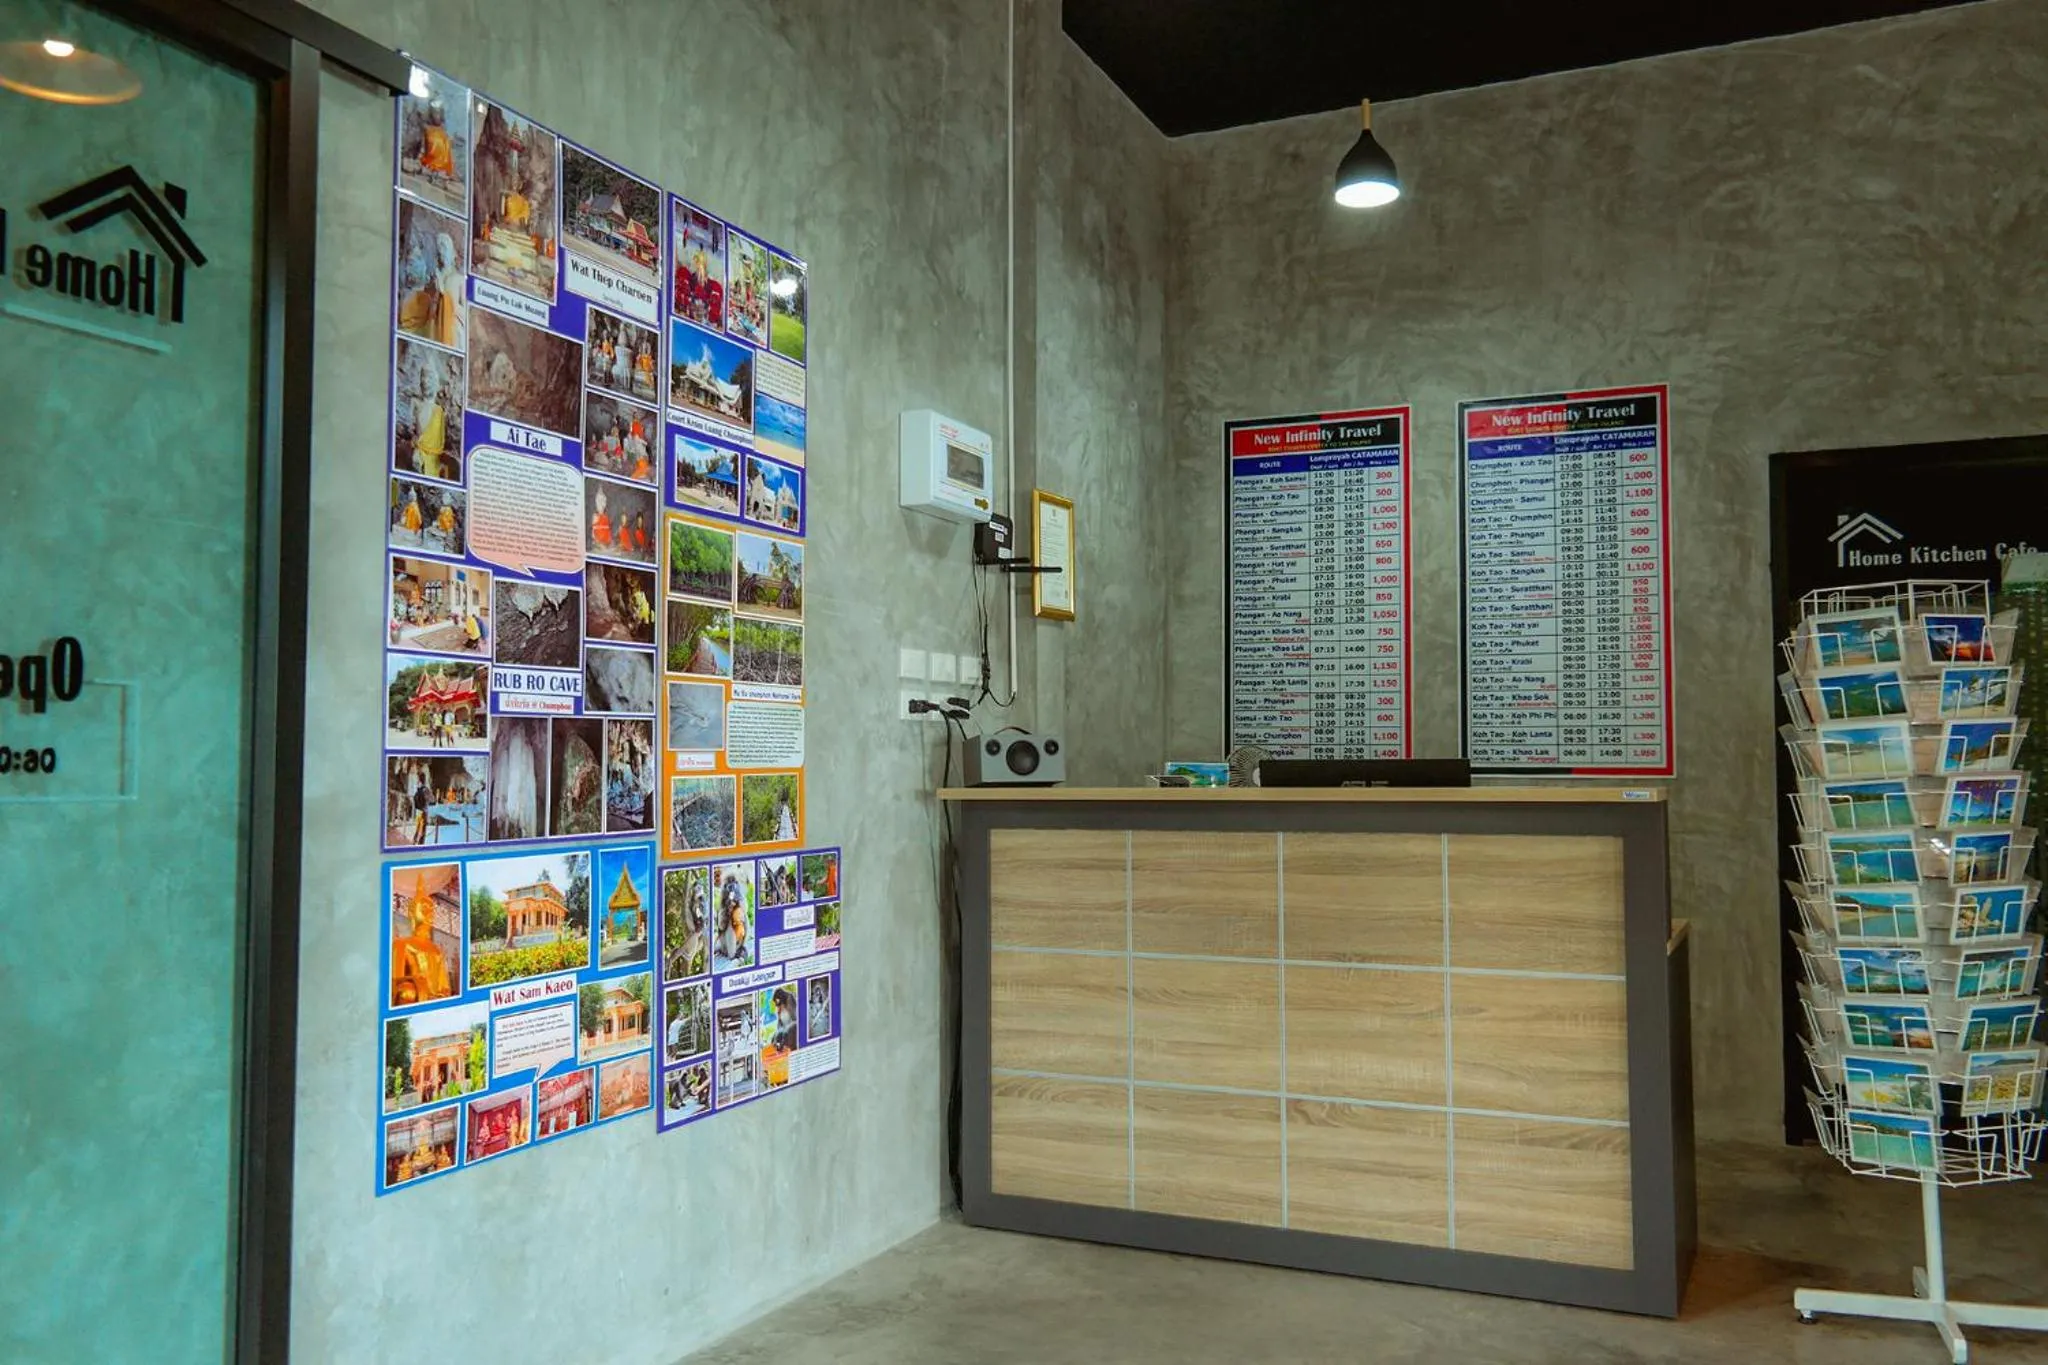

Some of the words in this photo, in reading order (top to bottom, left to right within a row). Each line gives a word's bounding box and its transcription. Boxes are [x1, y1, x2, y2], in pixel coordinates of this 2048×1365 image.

[571, 259, 589, 276] Wat
[1492, 415, 1523, 427] New
[1527, 410, 1581, 425] Infinity
[1588, 403, 1635, 419] Travel
[507, 427, 520, 444] Ai
[524, 432, 547, 451] Tae
[1254, 433, 1281, 446] New
[1285, 428, 1335, 443] Infinity
[1339, 423, 1381, 439] Travel
[1602, 430, 1655, 441] CATAMARAN
[1352, 449, 1398, 459] CATAMARAN
[1497, 444, 1523, 452] ROUTE
[1850, 550, 1902, 567] Home
[1910, 545, 1987, 564] Kitchen
[494, 672, 522, 689] RUB
[526, 674, 545, 690] RO
[550, 676, 581, 692] CAVE
[494, 990, 515, 1005] Wat
[520, 988, 541, 999] Sam
[545, 980, 573, 995] Kaeo
